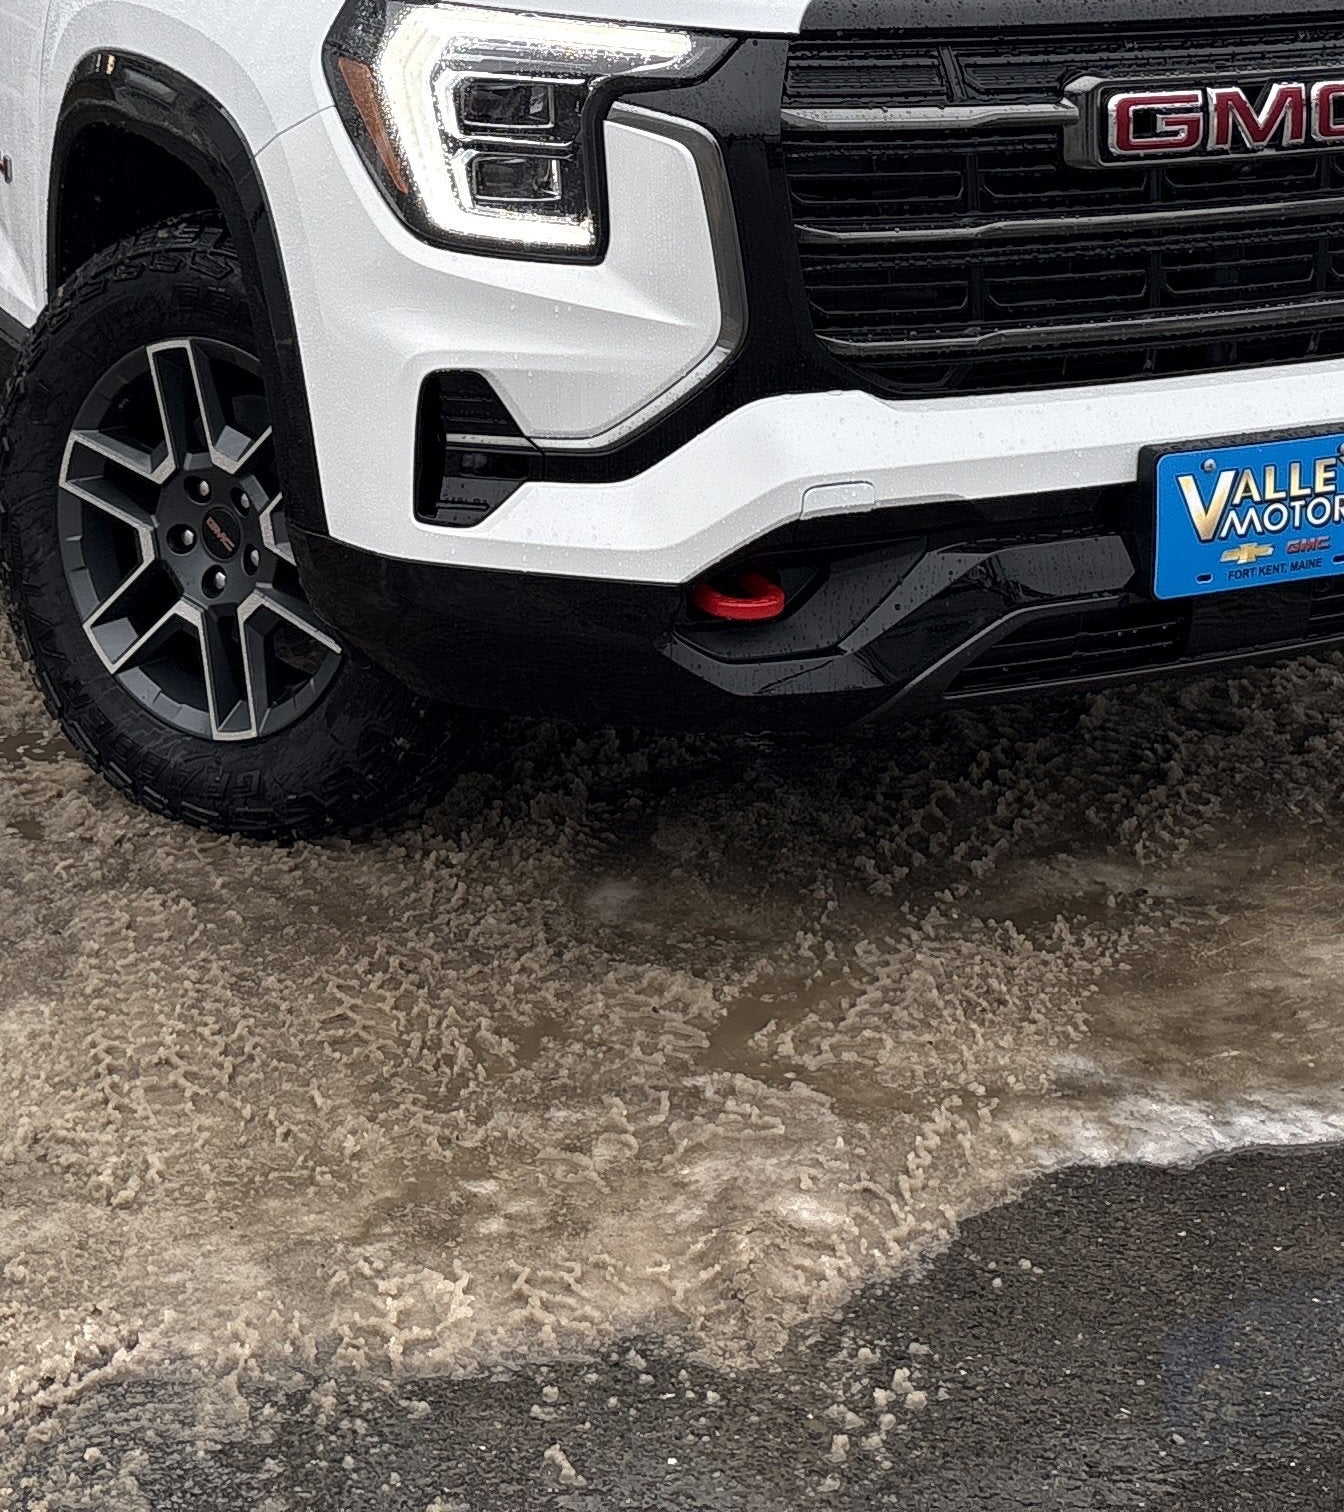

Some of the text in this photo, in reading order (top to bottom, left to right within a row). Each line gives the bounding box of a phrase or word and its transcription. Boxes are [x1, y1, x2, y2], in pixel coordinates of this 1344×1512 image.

[207, 517, 236, 552] GMC
[1286, 535, 1331, 555] GMC
[1227, 568, 1256, 581] FORT
[1289, 557, 1323, 572] MAINE
